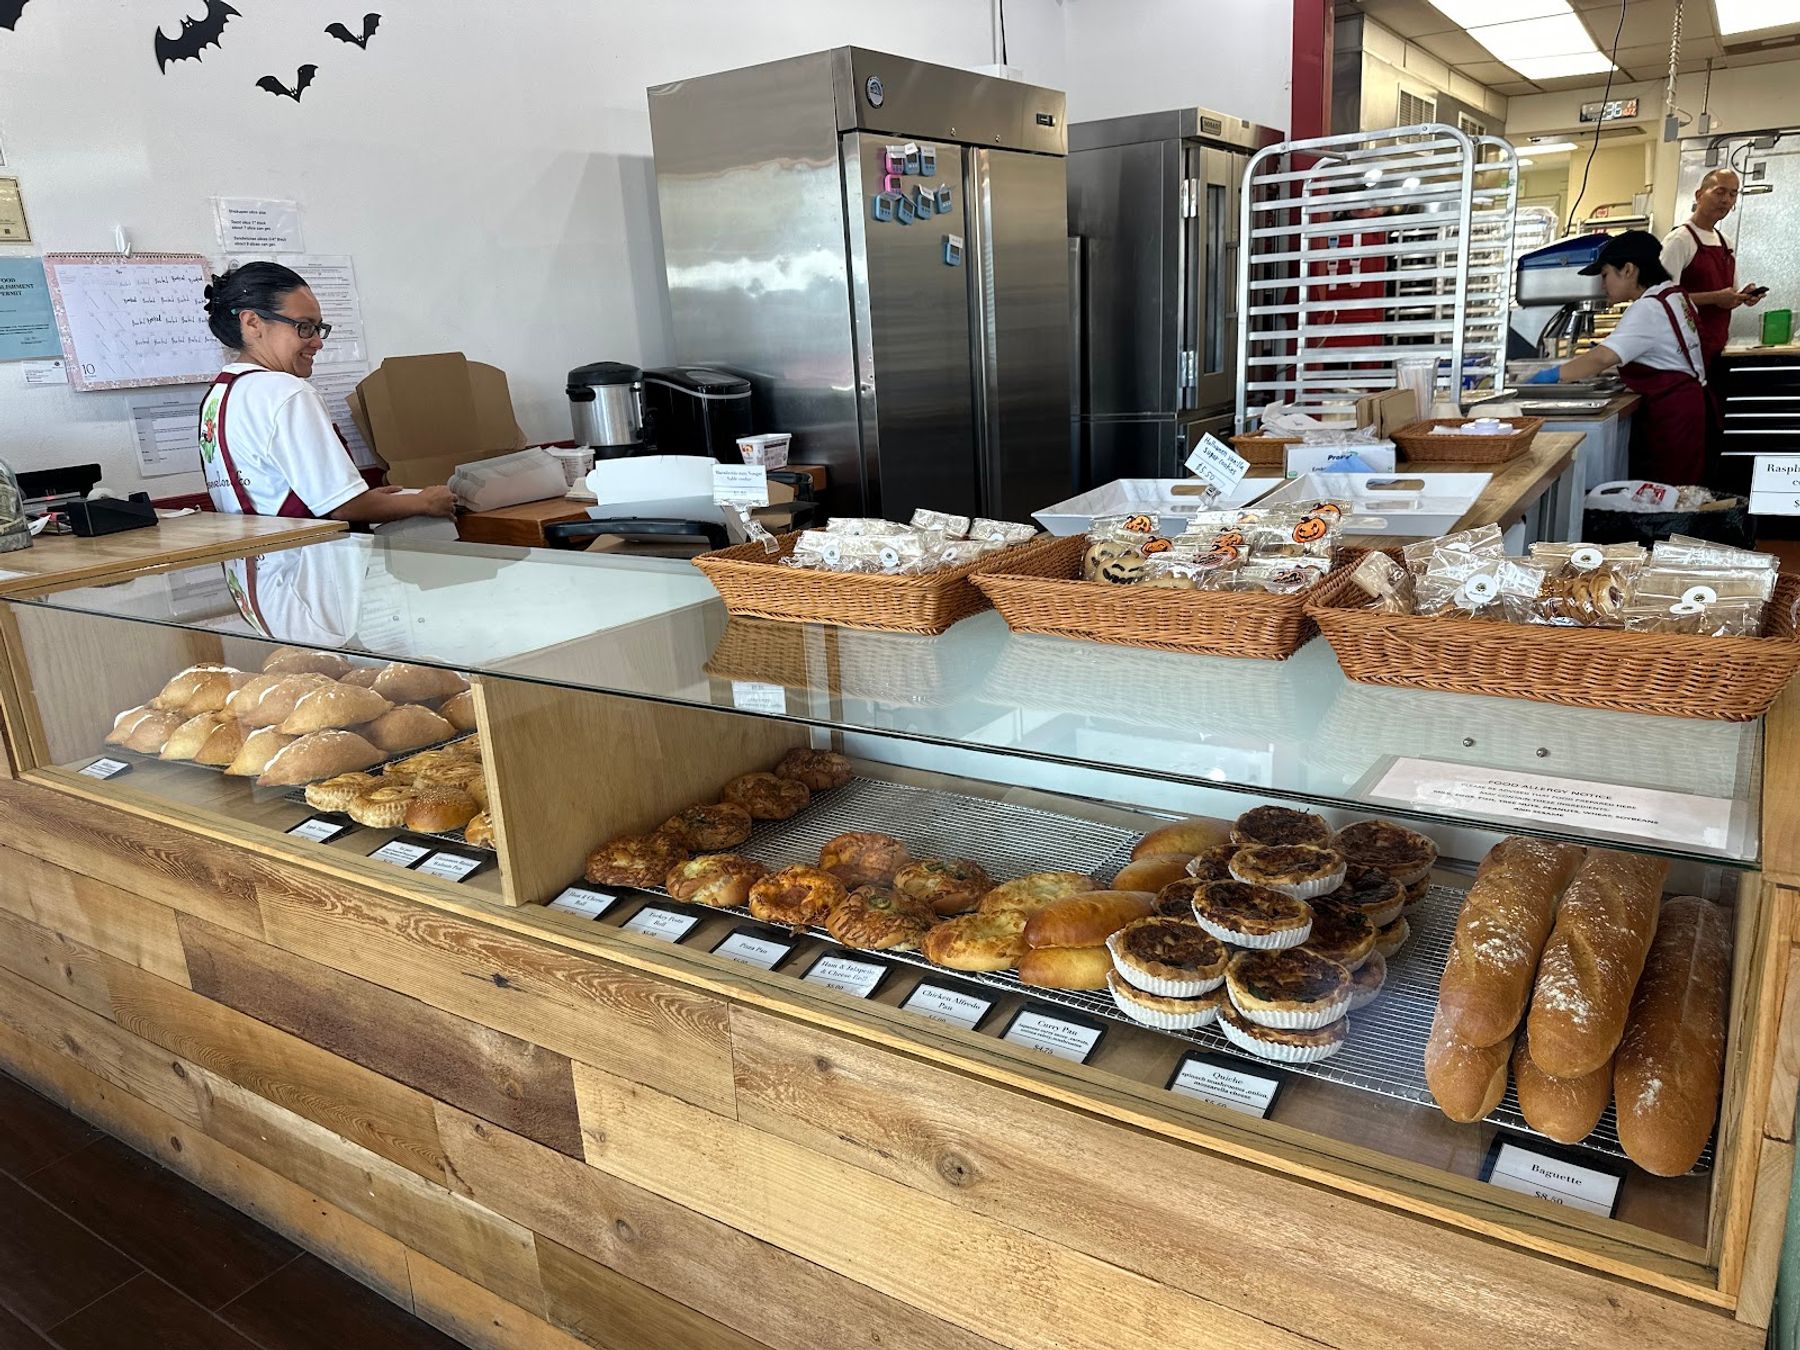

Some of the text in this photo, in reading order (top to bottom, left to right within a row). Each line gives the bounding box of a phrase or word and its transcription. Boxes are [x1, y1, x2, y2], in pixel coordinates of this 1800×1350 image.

[81, 363, 96, 375] 10
[1487, 779, 1612, 800] FOOD ALLERGY NOTICE
[821, 960, 838, 969] Ham
[827, 970, 852, 979] Cheese
[922, 989, 981, 1010] Chicken Alfredo
[938, 1002, 953, 1012] Pan
[1037, 1020, 1079, 1036] Curry Pan
[1032, 1044, 1054, 1055] $4.75
[1181, 1072, 1206, 1082] spinach
[1212, 1071, 1244, 1085] Quiche
[1229, 1090, 1252, 1100] cheese
[1531, 1164, 1583, 1186] Baguette
